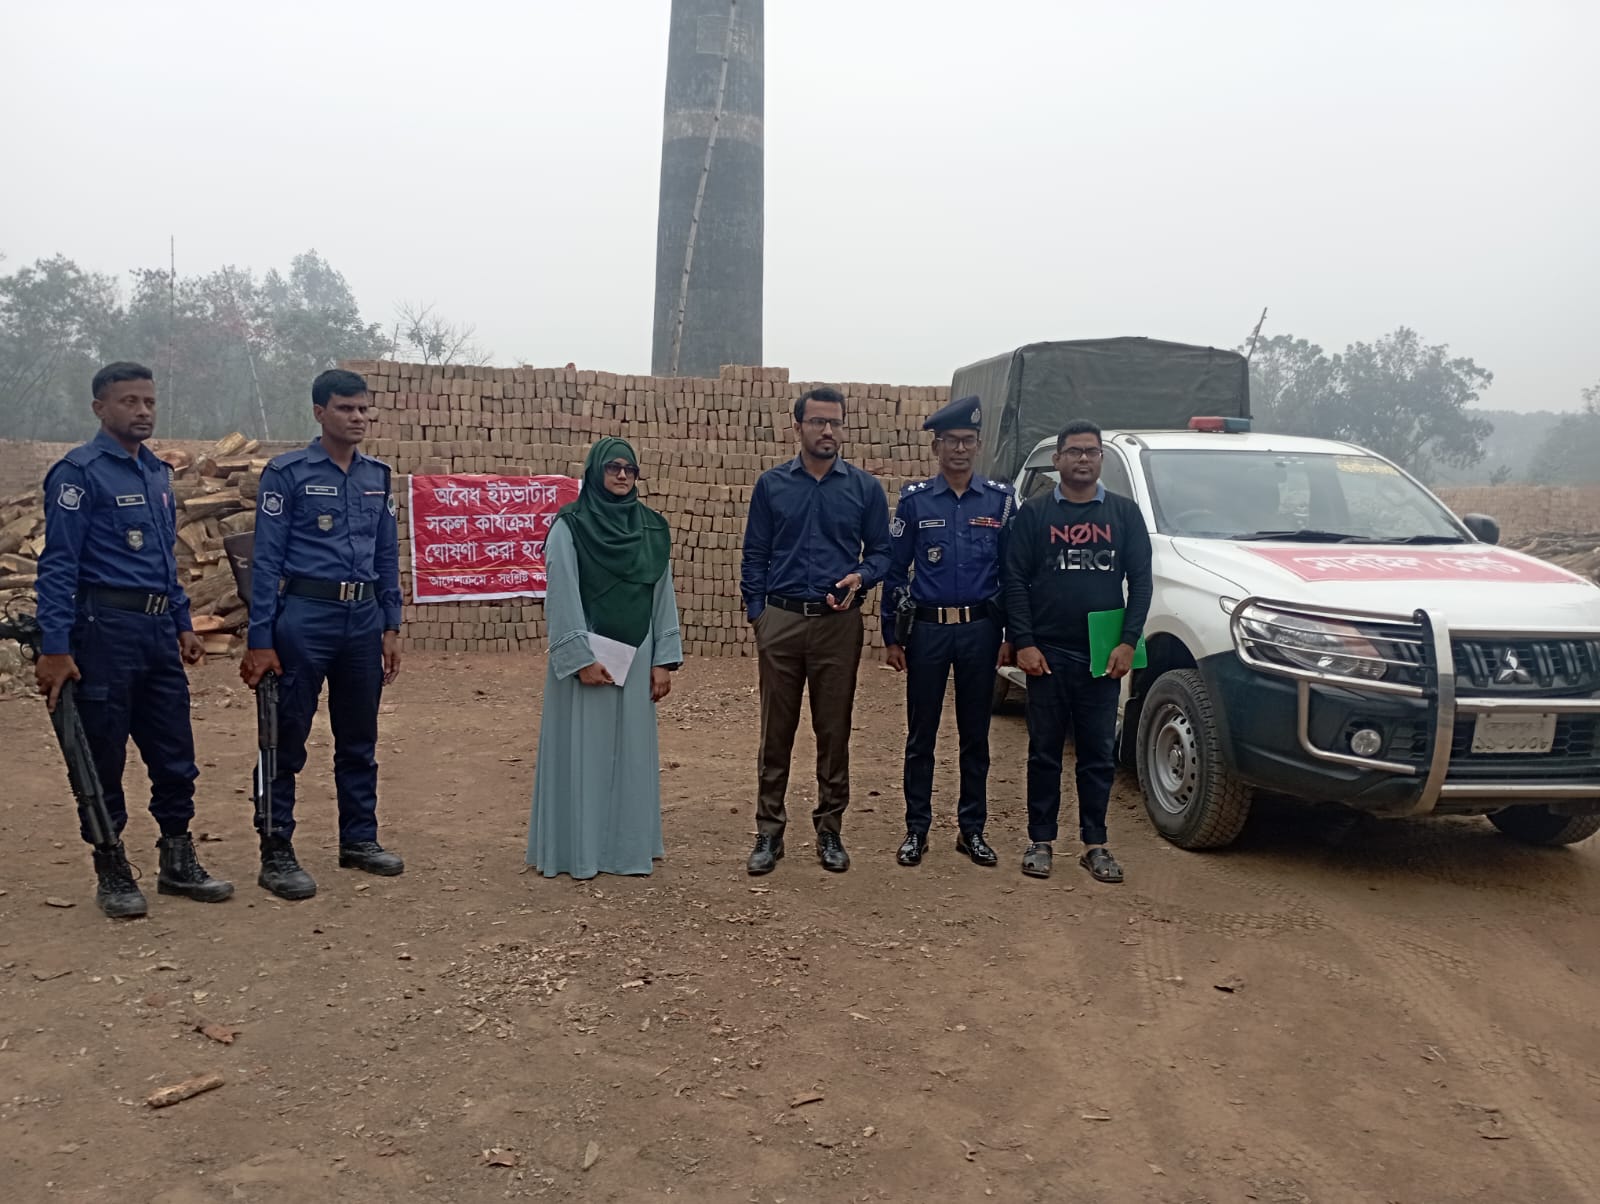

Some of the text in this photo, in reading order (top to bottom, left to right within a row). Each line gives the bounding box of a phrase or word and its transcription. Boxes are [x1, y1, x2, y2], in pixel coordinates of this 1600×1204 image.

[432, 480, 558, 507] অবৈধ ইটভাটার
[424, 514, 469, 535] সকল
[473, 507, 536, 534] কার্যক্রম
[424, 540, 478, 564] ঘোষণা
[483, 540, 516, 561] করা
